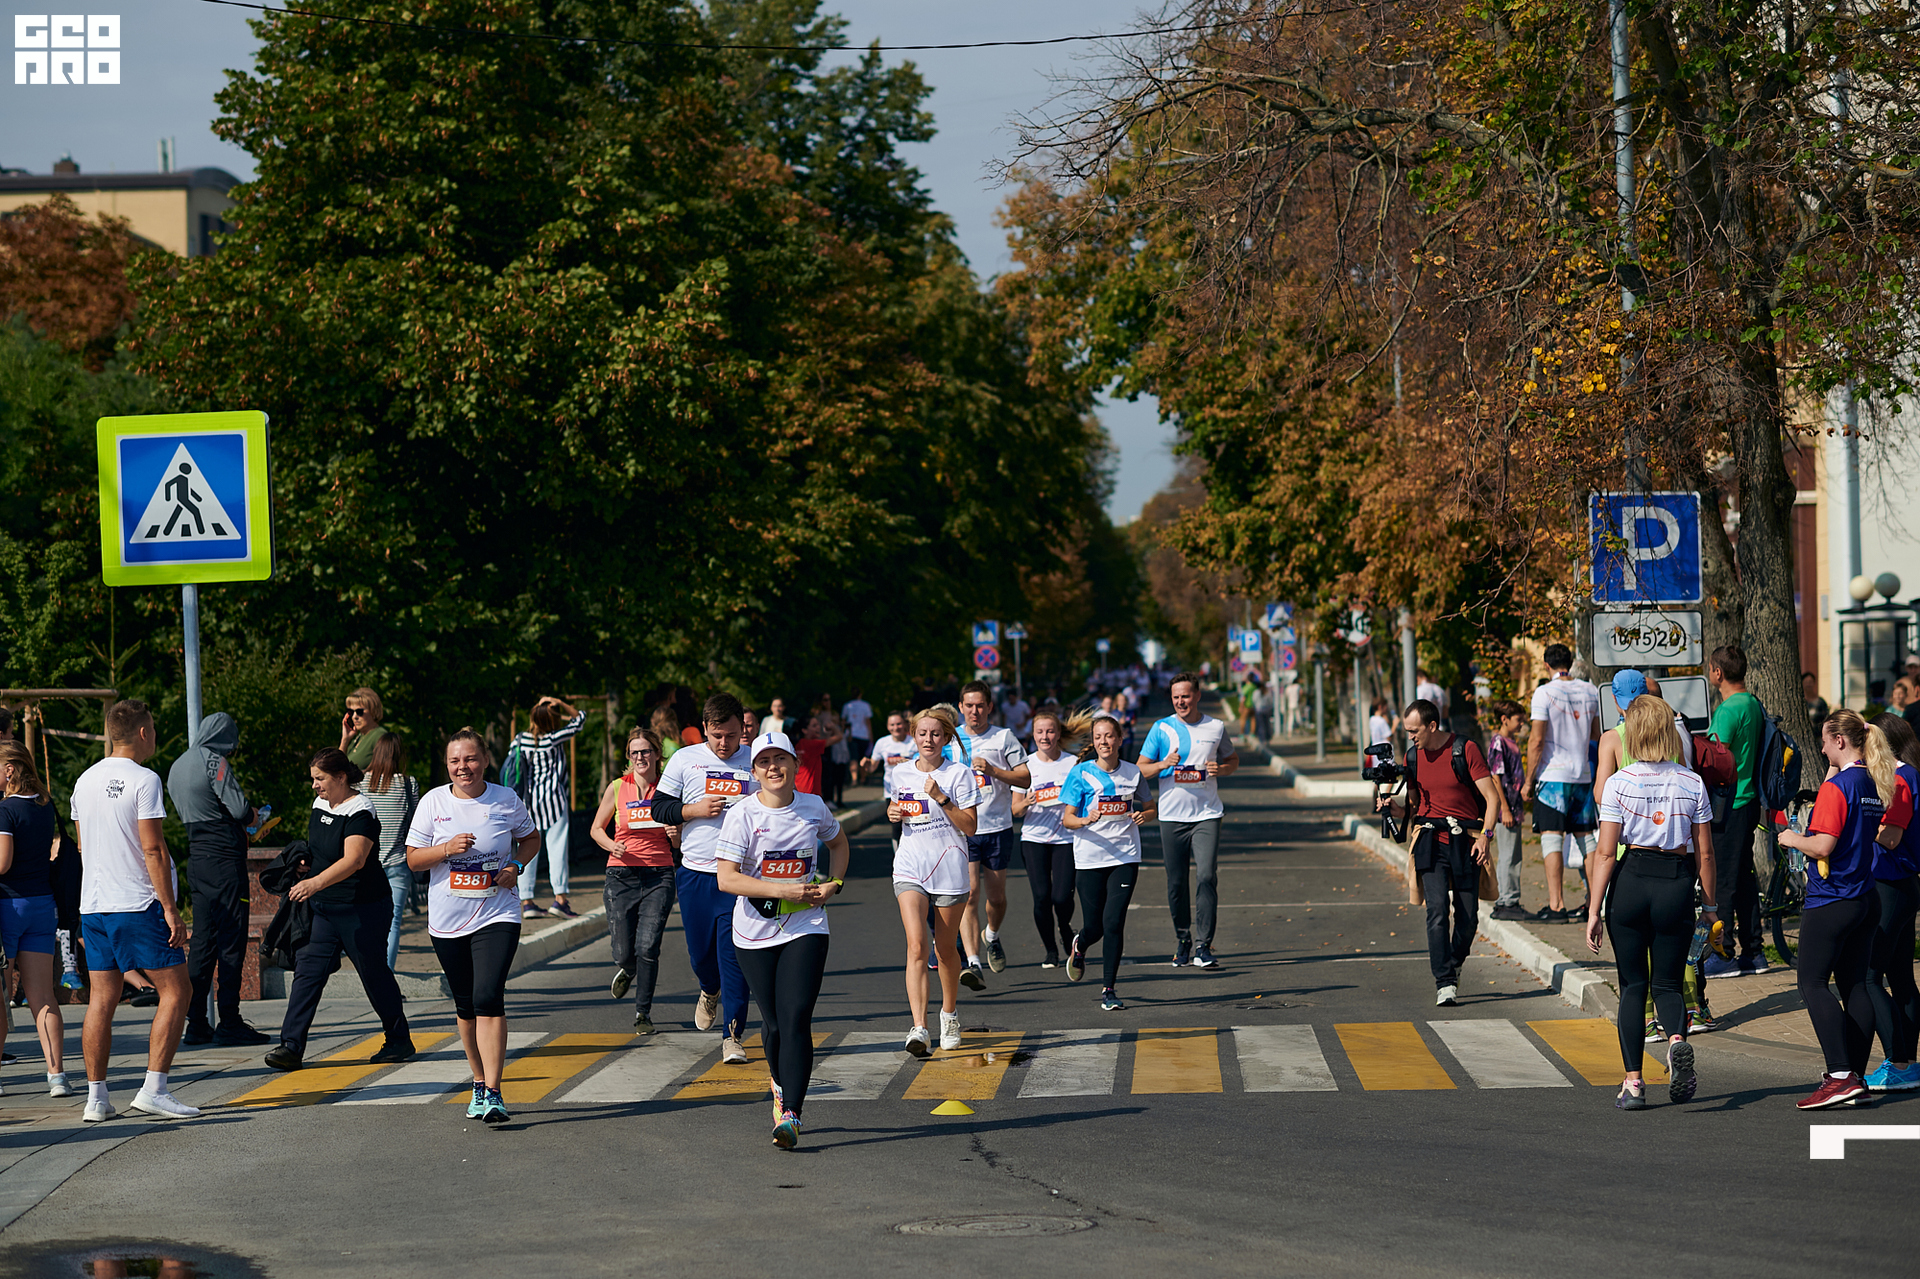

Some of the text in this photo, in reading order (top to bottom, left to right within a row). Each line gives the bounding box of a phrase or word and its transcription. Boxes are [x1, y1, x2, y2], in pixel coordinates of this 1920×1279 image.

[1622, 506, 1680, 590] P
[1245, 632, 1258, 650] P
[766, 733, 774, 744] 1
[1177, 772, 1200, 780] 5080
[708, 780, 740, 792] 5475
[1038, 787, 1061, 800] 5068
[898, 802, 920, 813] 480
[1101, 803, 1126, 812] 5305
[630, 808, 651, 820] 502
[766, 861, 803, 874] 5412
[453, 874, 487, 886] 5381
[764, 901, 773, 910] R
